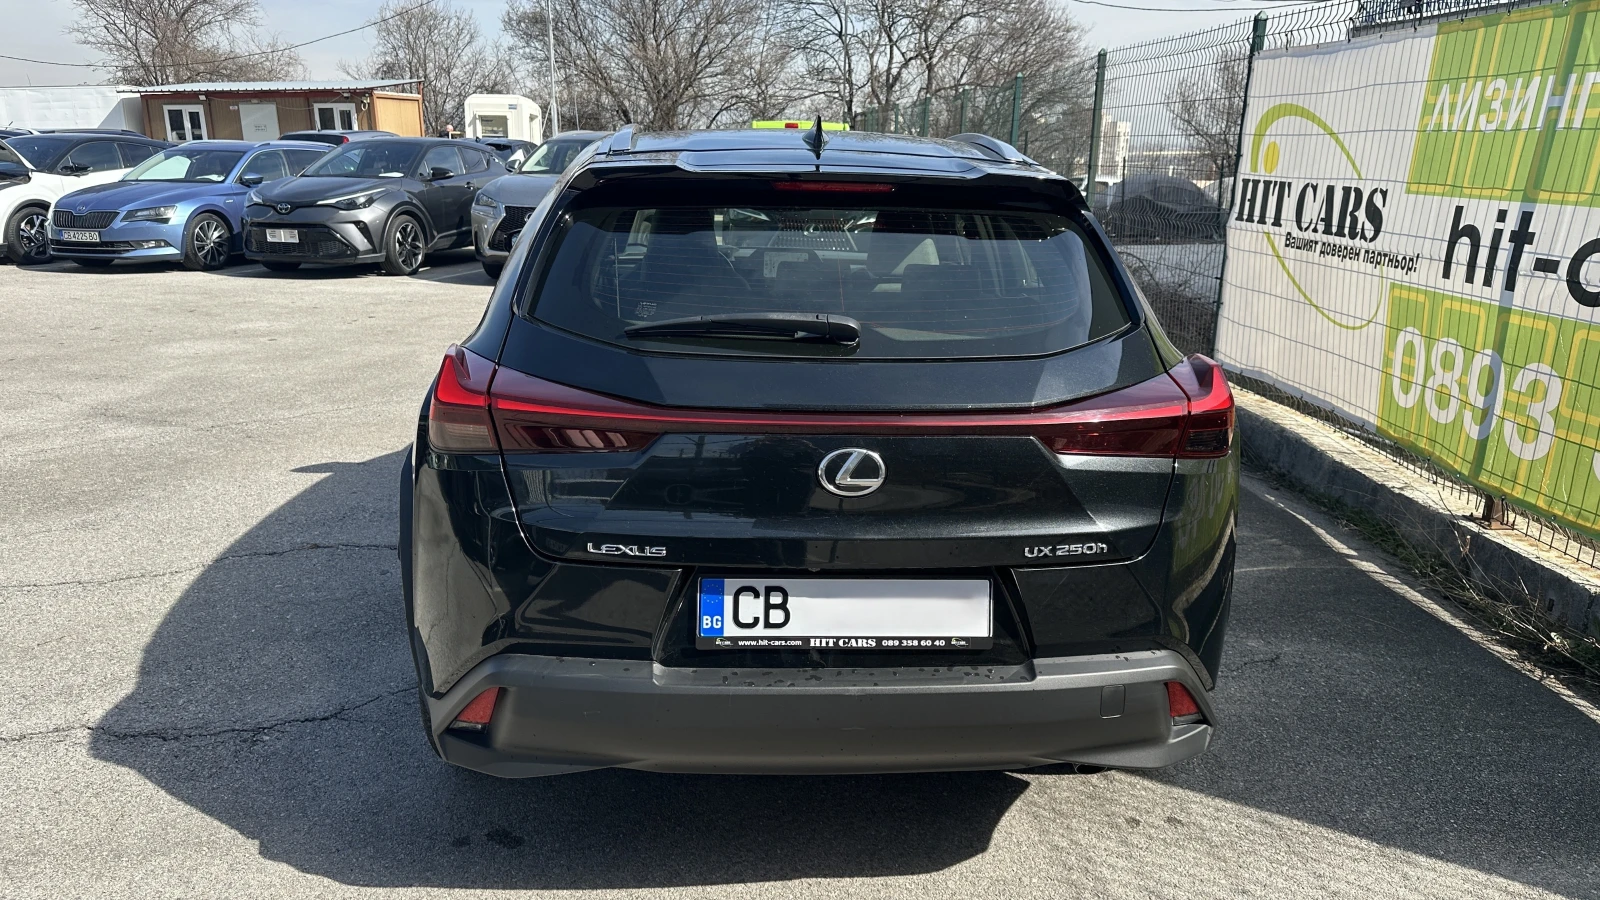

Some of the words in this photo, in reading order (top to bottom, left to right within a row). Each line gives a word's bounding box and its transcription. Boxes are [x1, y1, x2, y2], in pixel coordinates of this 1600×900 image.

[1235, 178, 1292, 228] HIT
[1295, 182, 1388, 243] CARS
[1284, 231, 1319, 254] Вашият
[1319, 240, 1362, 263] доверен
[1362, 250, 1420, 276] партньор!
[1390, 326, 1563, 461] 0893
[587, 542, 667, 557] LEXUS
[1024, 546, 1053, 558] UX
[1055, 542, 1108, 556] 250h
[732, 585, 791, 629] CB
[702, 615, 722, 629] BG
[738, 639, 802, 647] www.hit-cars.com
[809, 638, 836, 647] HIT
[838, 638, 877, 648] CARS
[881, 639, 899, 647] 089
[901, 639, 919, 647] 358
[920, 639, 932, 647] 60
[933, 639, 946, 647] 40
